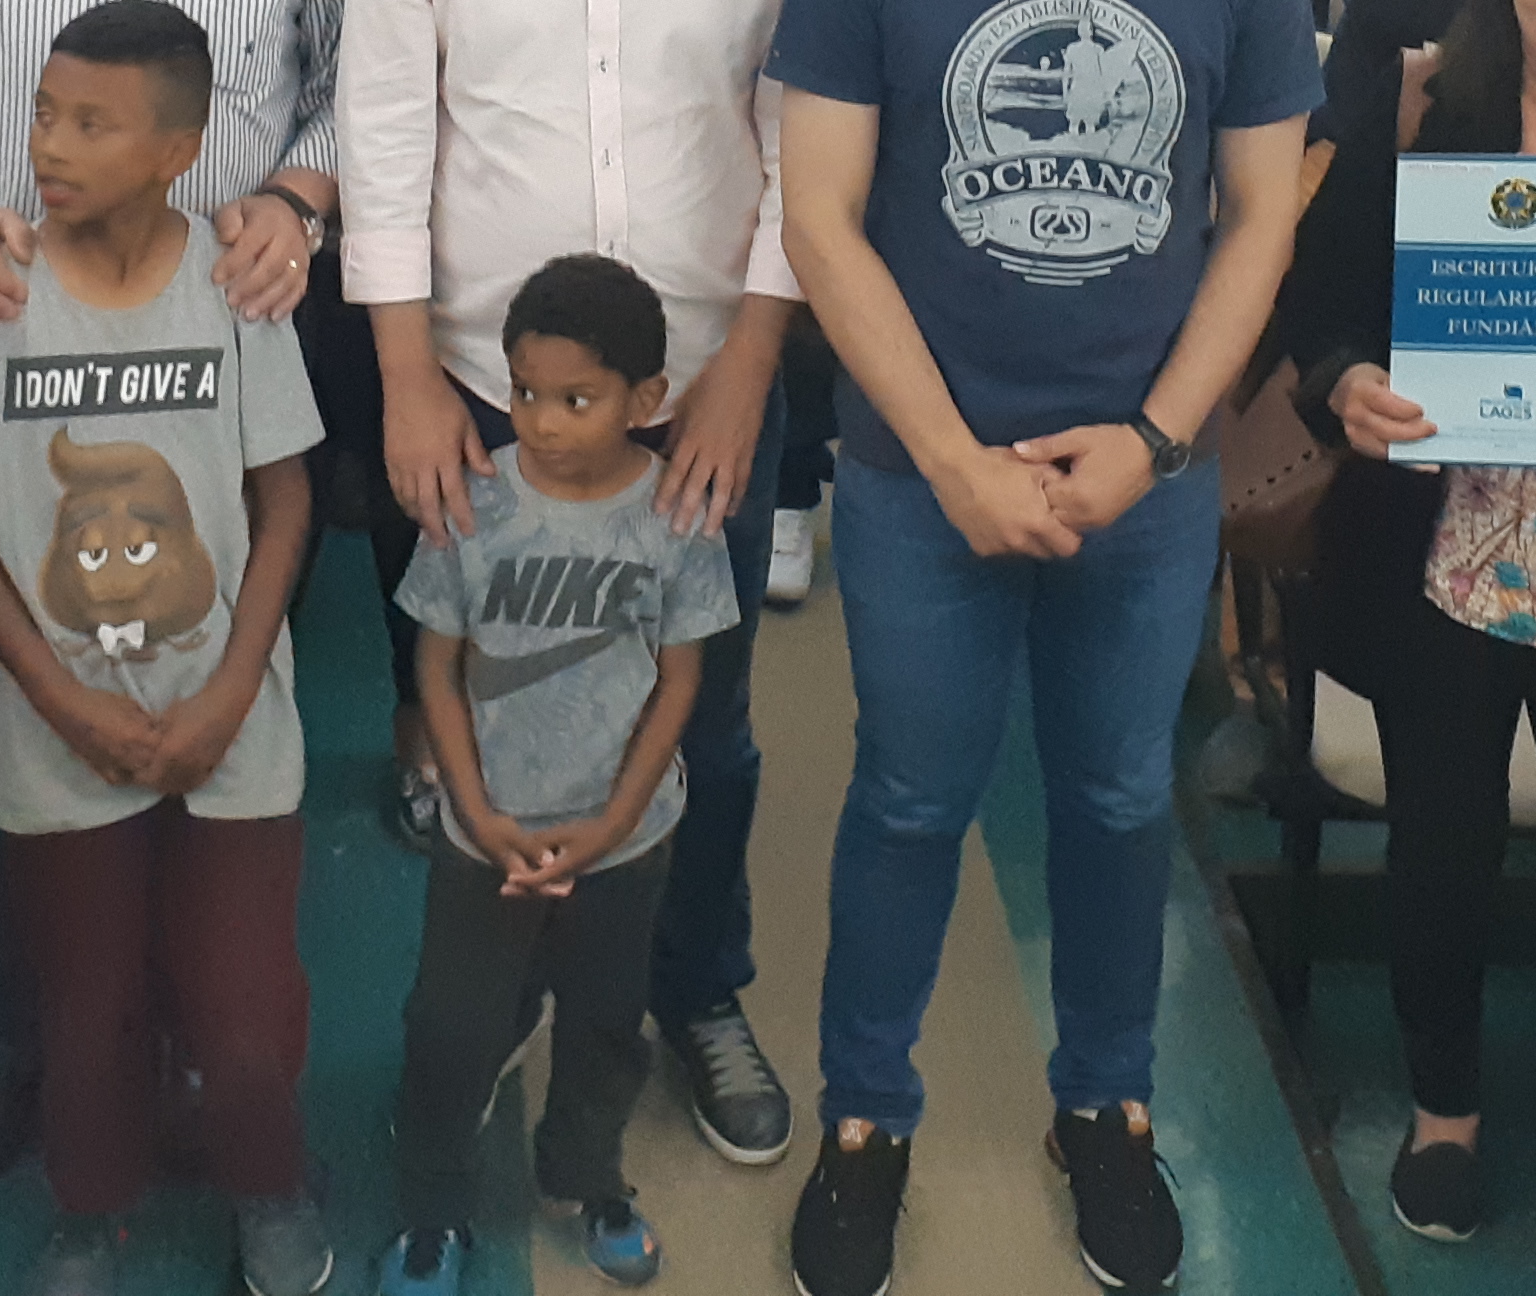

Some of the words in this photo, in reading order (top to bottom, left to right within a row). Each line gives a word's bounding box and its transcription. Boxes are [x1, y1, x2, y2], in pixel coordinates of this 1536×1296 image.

[956, 158, 1159, 205] OCEANO
[15, 371, 22, 407] I
[27, 361, 112, 406] DON'T
[120, 362, 191, 404] GIVE
[197, 362, 214, 398] A
[1479, 405, 1532, 420] LAGES
[480, 557, 659, 627] NIKE
